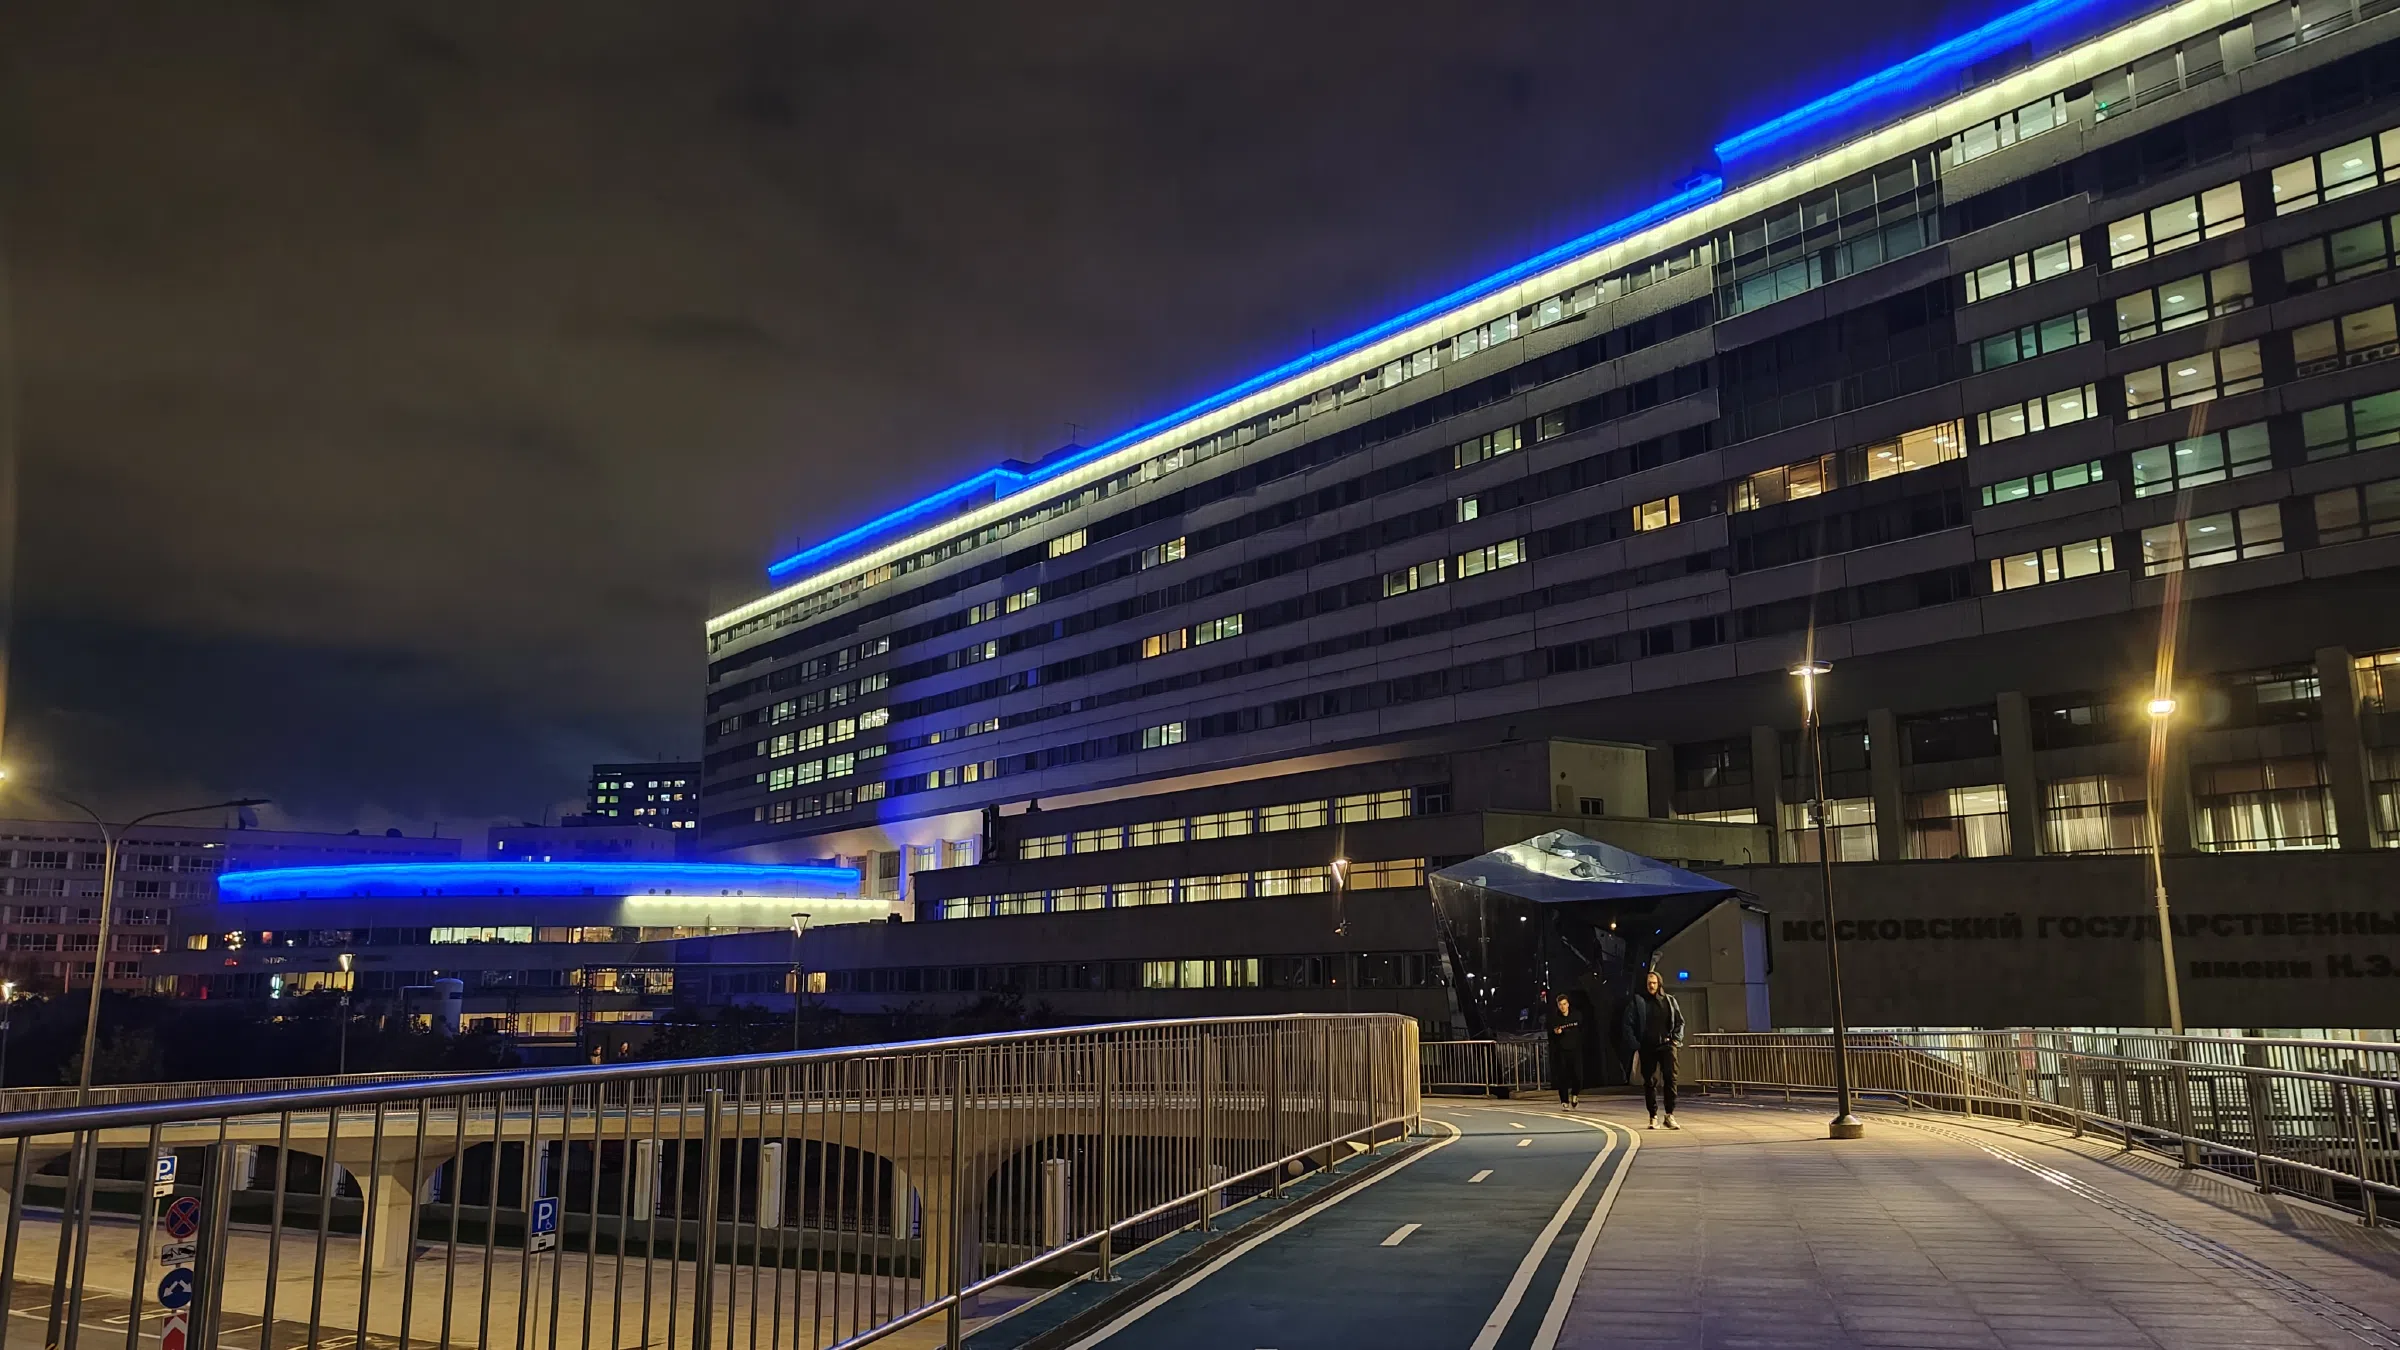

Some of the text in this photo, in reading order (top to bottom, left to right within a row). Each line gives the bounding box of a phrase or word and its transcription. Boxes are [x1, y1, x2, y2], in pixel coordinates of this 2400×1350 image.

[1782, 912, 2022, 941] МОСКОВСКИЙ
[155, 1160, 171, 1180] P
[538, 1203, 552, 1229] P
